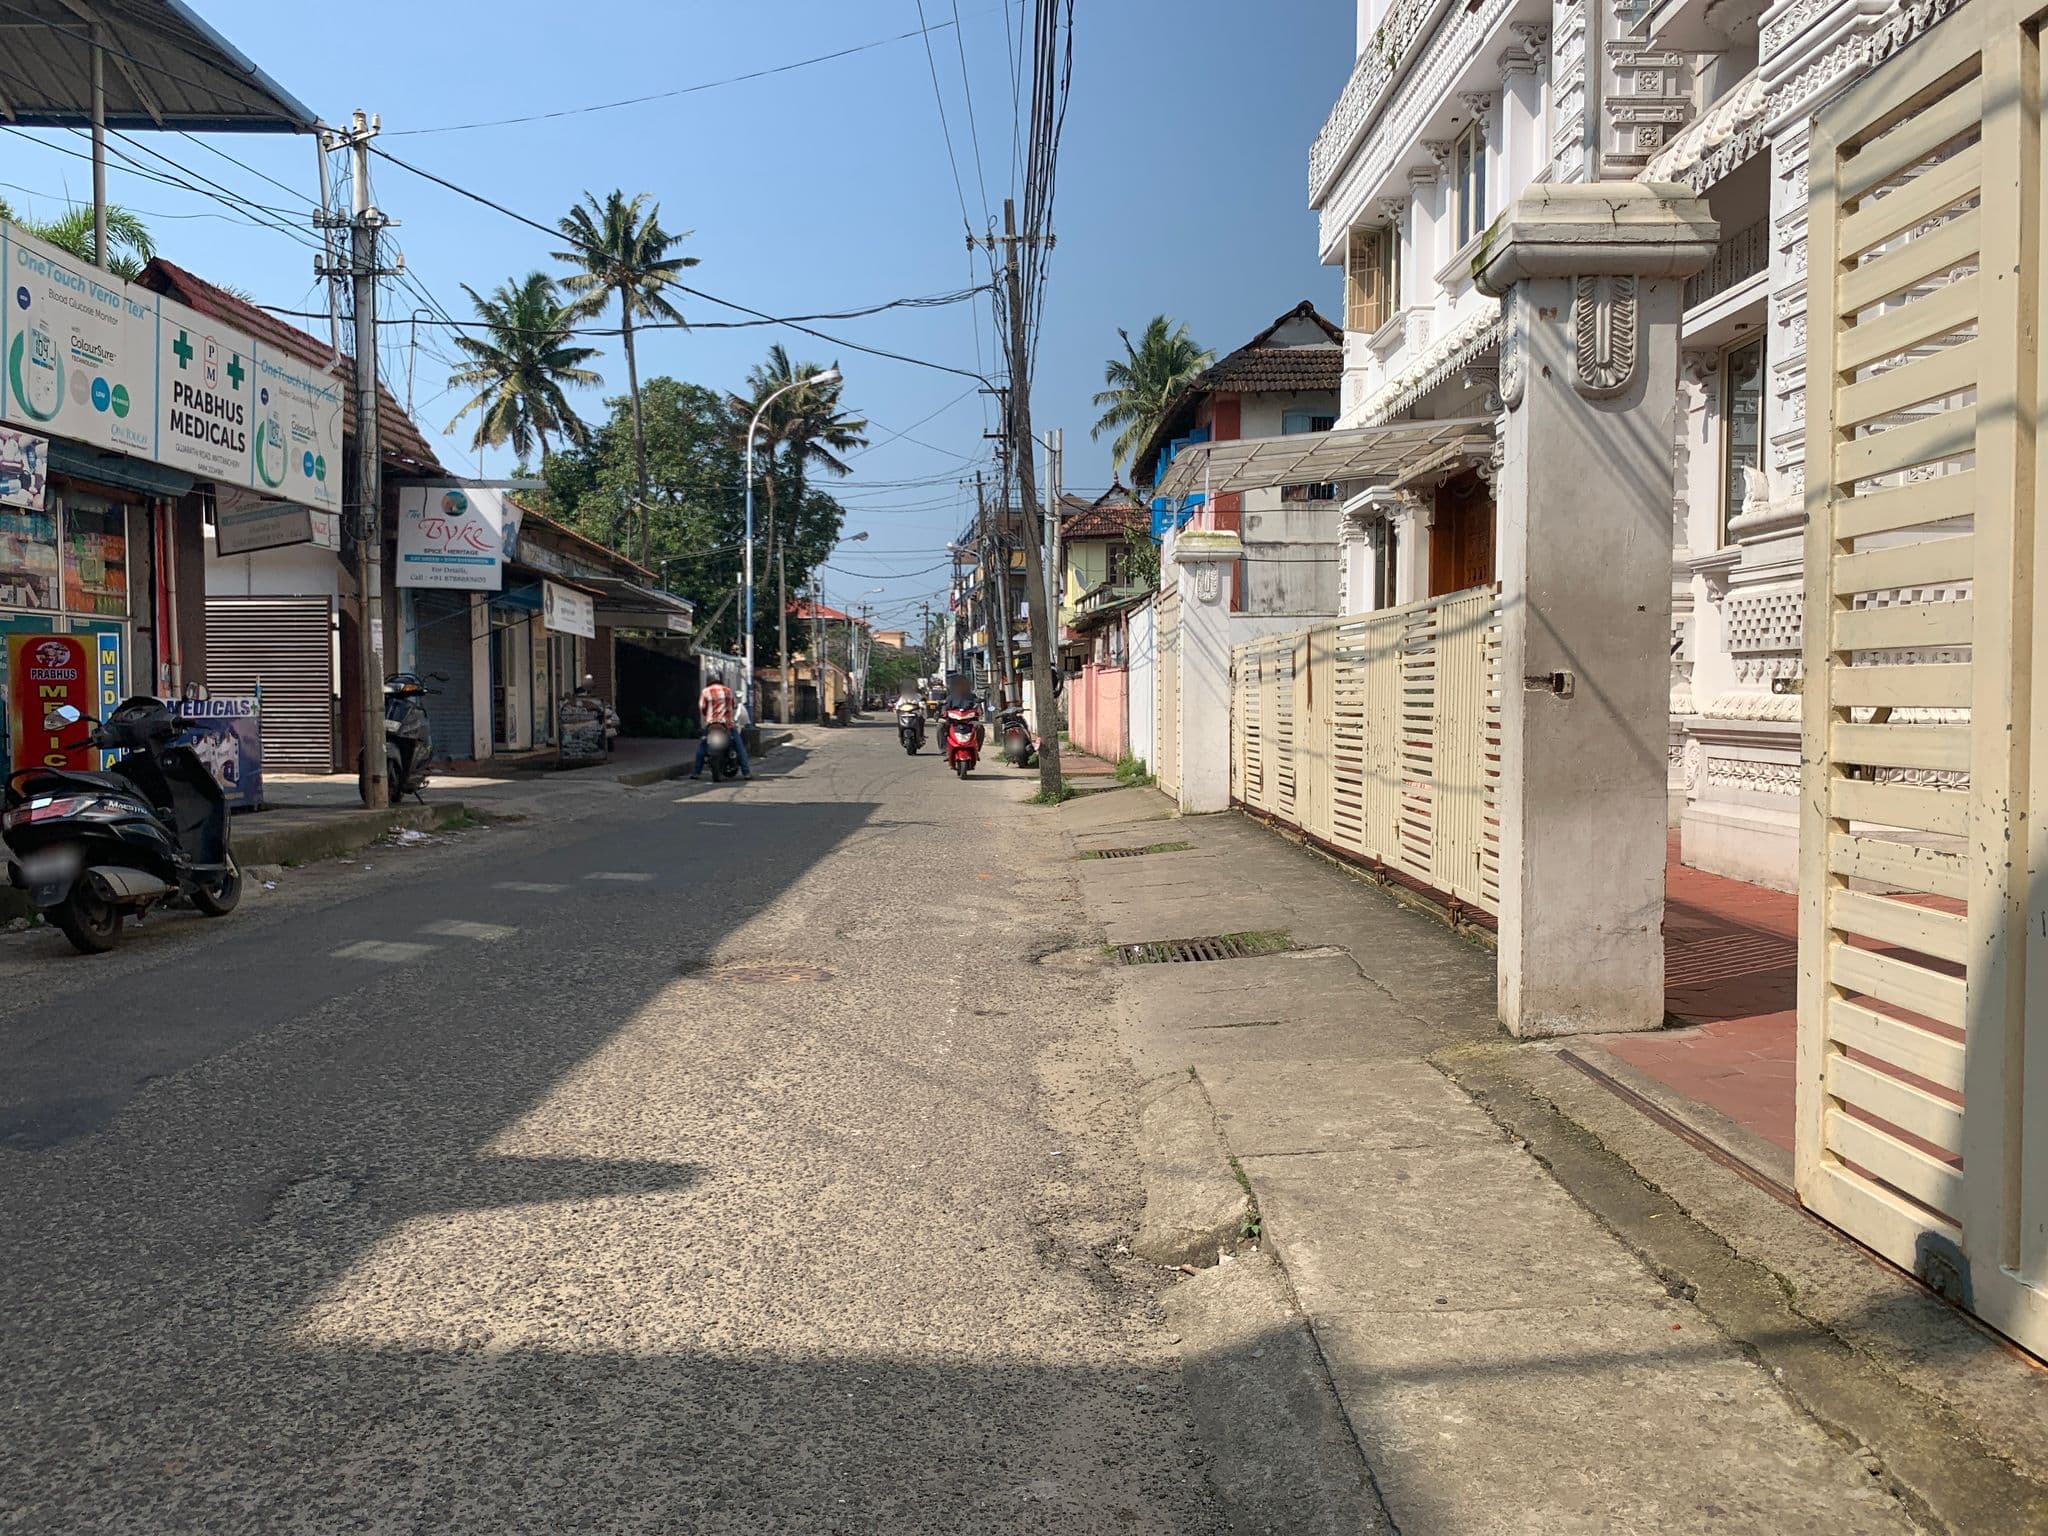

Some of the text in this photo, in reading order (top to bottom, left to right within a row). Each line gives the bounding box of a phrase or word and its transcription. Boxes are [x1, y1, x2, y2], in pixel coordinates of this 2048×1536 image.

[48, 288, 119, 326] Blood Glucose Monitor
[208, 345, 215, 358] P
[206, 367, 215, 382] M
[174, 381, 244, 426] PRABHUS
[170, 409, 246, 453] MEDICALS
[418, 518, 496, 552] Byke
[447, 548, 479, 556] HERITAGE
[31, 668, 77, 680] PRABHUS
